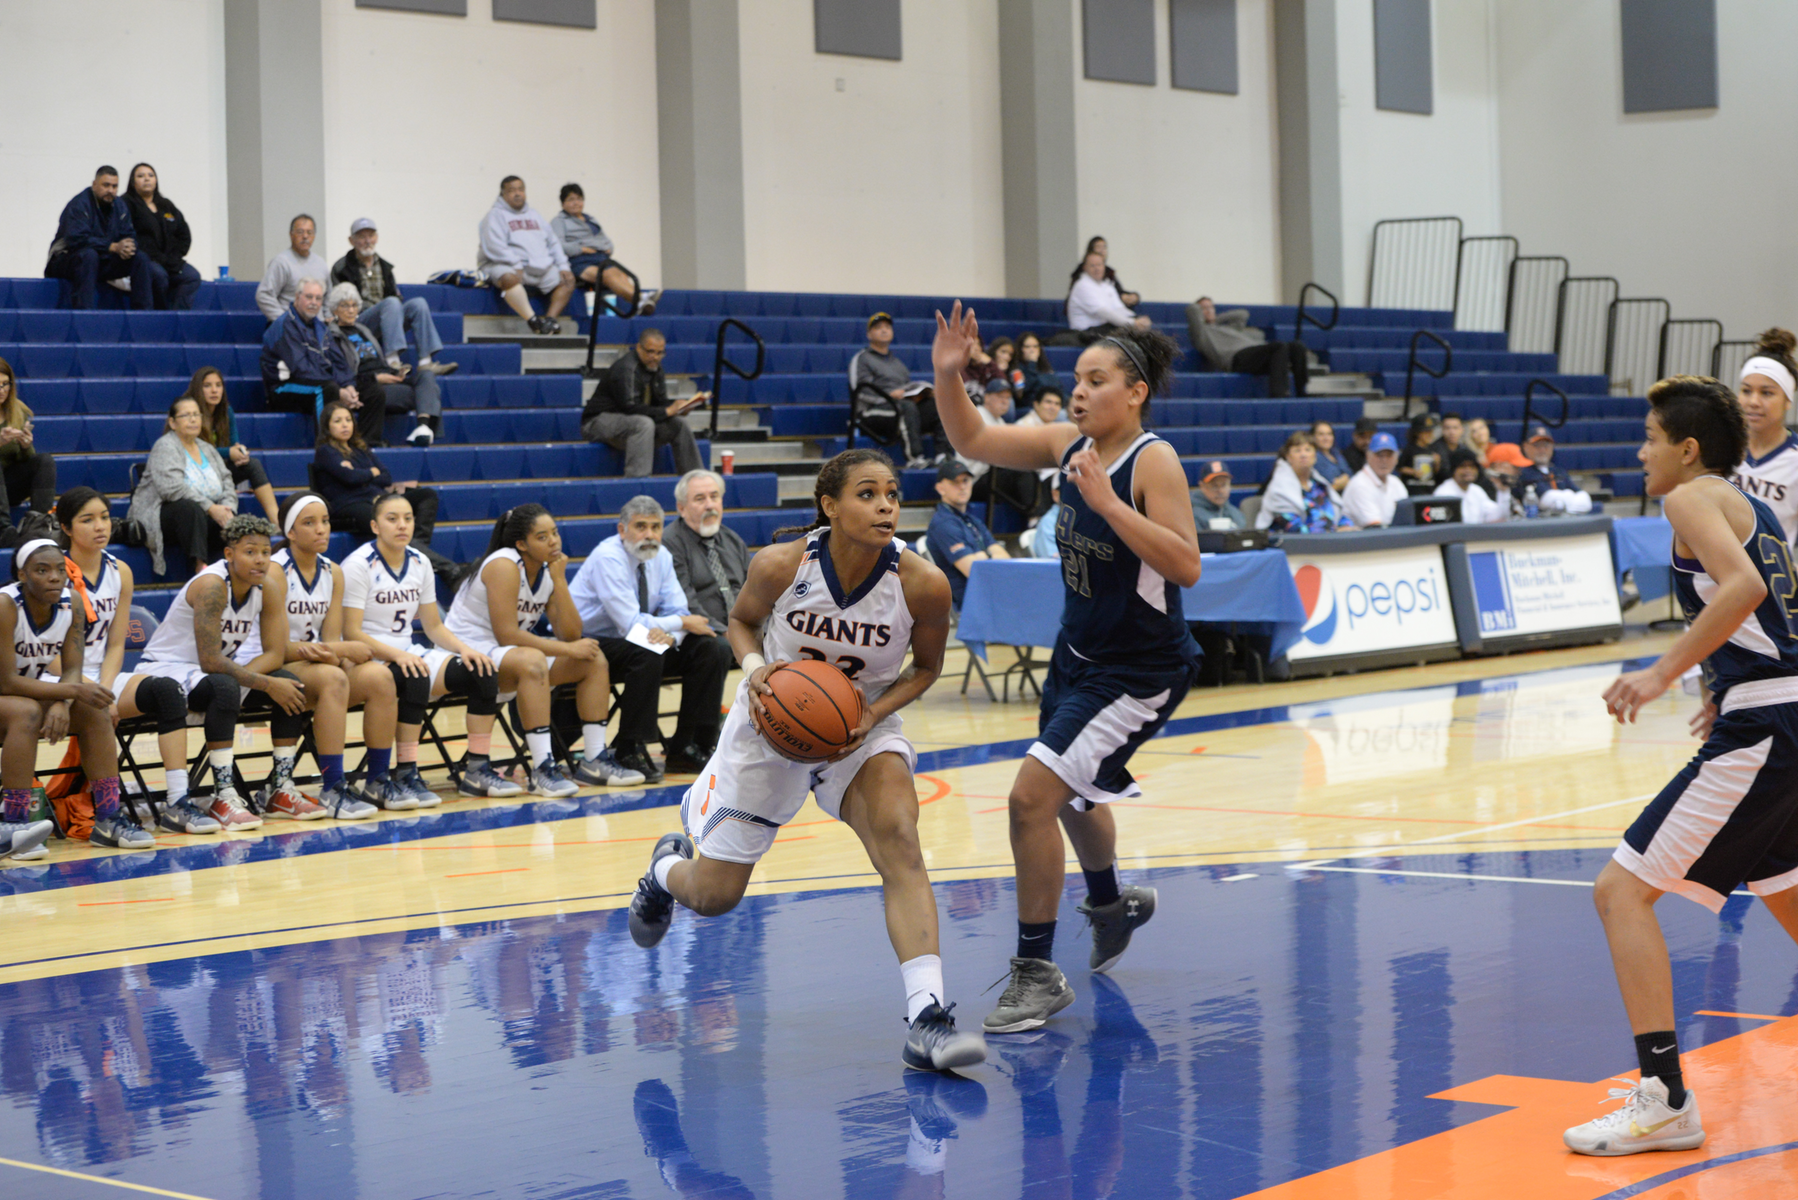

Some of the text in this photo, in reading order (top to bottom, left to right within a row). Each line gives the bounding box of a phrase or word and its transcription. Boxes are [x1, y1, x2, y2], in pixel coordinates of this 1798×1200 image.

[1733, 473, 1787, 501] ANTS
[375, 588, 420, 604] GIANTS
[1346, 567, 1440, 629] pepsi
[391, 609, 406, 633] 5
[786, 609, 891, 647] GIANTS
[15, 641, 62, 657] GIANTS
[763, 708, 813, 753] EVOLUTIO
